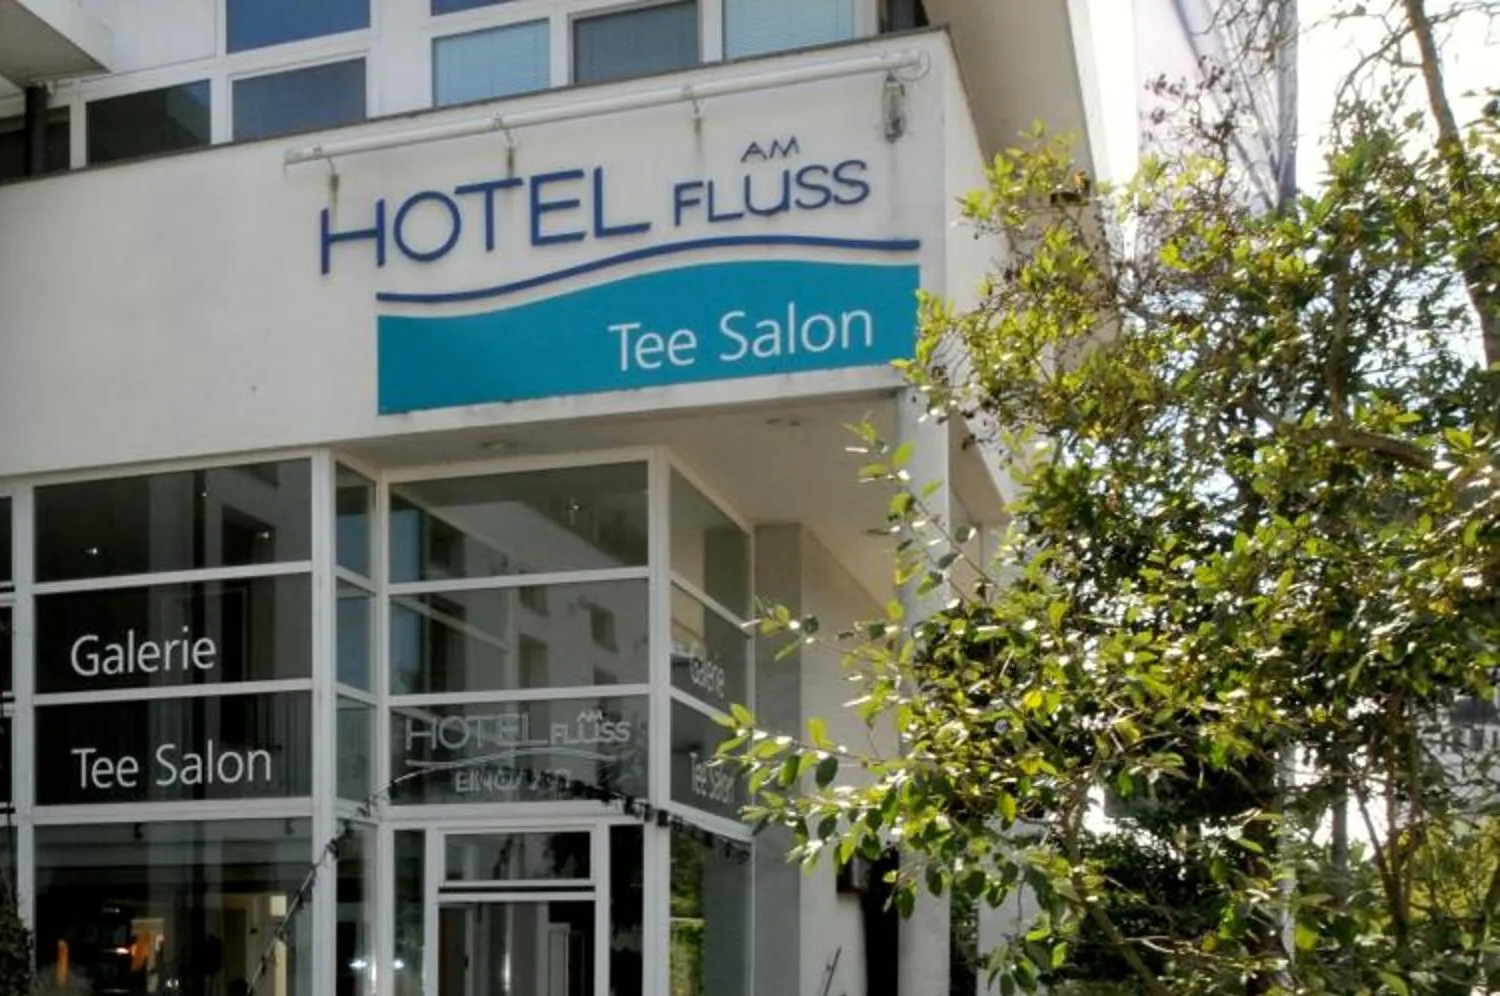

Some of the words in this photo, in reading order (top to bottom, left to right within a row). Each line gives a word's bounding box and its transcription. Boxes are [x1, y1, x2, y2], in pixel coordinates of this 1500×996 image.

[740, 136, 799, 162] AM
[320, 166, 651, 275] HOTEL
[673, 160, 871, 227] FLUSS
[608, 321, 698, 373] Tee
[719, 301, 874, 363] Salon
[70, 625, 217, 677] Galerie
[405, 713, 548, 750] HOTEL
[551, 721, 631, 745] FLUSS
[70, 748, 139, 789] Tee
[155, 739, 272, 787] Salon
[454, 768, 571, 793] EING
